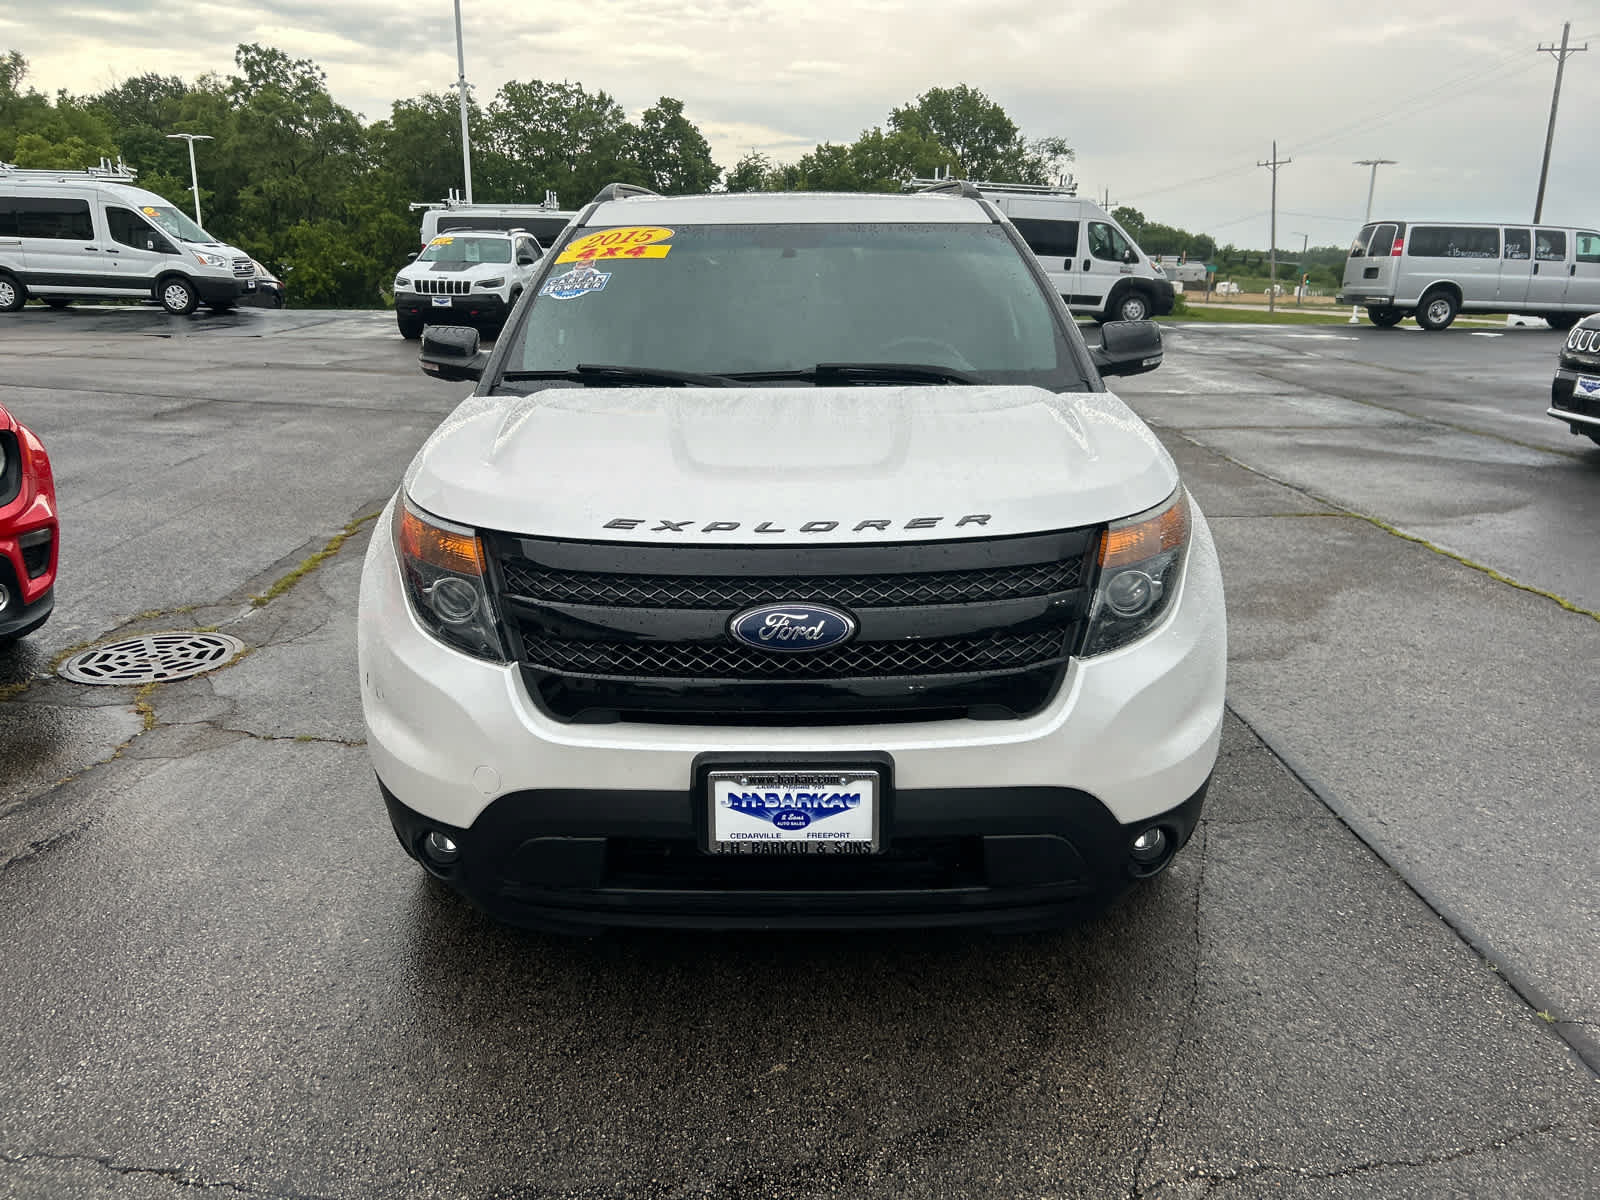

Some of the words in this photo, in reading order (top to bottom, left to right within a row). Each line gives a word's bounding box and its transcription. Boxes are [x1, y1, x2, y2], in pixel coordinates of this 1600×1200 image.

[580, 229, 657, 250] 2015
[602, 514, 992, 532] EXPLORER
[758, 612, 826, 641] Ford
[749, 774, 840, 785] www.barkau.com
[751, 841, 809, 854] BARKAU
[816, 841, 826, 854] &
[834, 841, 872, 854] SONS
